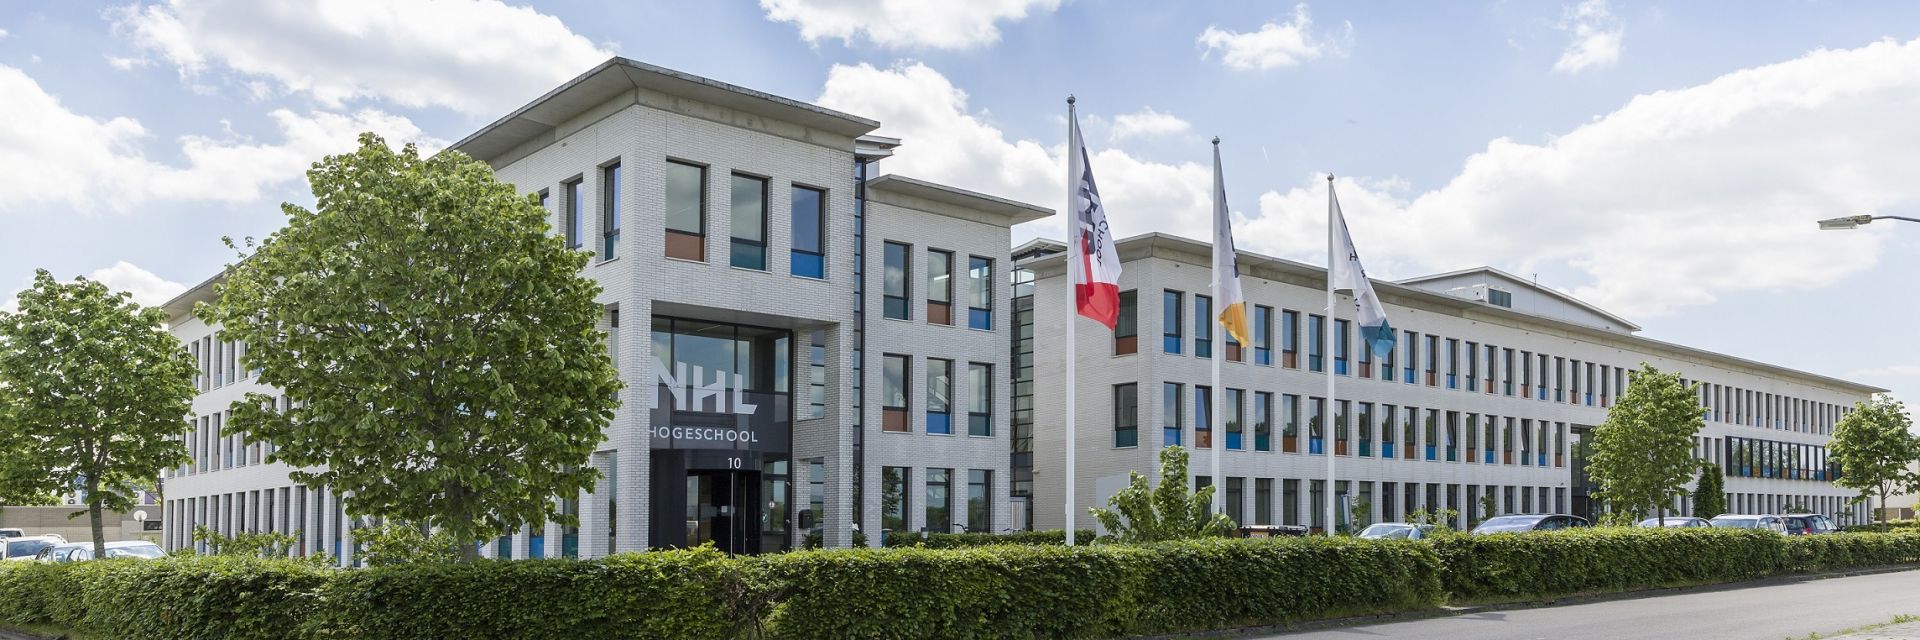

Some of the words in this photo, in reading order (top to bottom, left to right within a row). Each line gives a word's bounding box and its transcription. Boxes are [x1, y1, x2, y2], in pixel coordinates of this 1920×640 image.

[650, 355, 758, 415] NHL
[650, 426, 758, 442] HOGESCHOOL
[727, 457, 742, 470] 10
